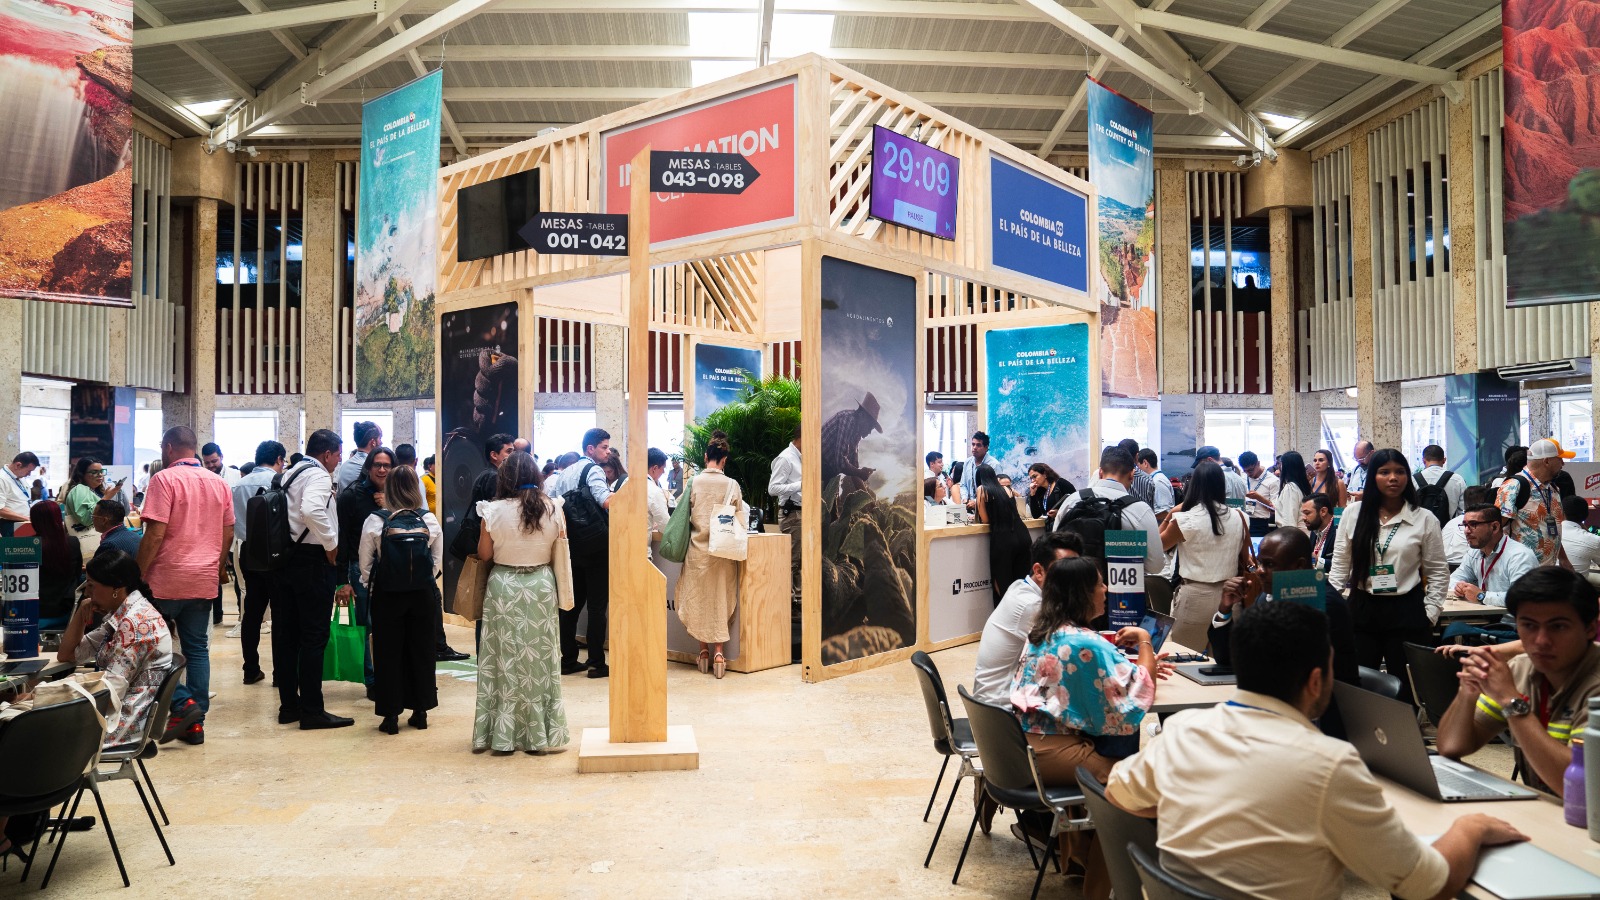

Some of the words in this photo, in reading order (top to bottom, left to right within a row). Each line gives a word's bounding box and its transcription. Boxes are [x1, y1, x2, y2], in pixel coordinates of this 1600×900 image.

[369, 140, 375, 149] EL
[389, 131, 397, 141] DE
[398, 128, 406, 138] LA
[406, 118, 431, 135] BELLEZA
[1095, 123, 1105, 134] THE
[668, 158, 711, 171] MESAS
[882, 141, 950, 197] 29:09
[662, 171, 745, 188] 043-098
[907, 210, 924, 222] PAUSE
[1020, 208, 1056, 233] COLOMBIA
[540, 218, 583, 230] MESAS
[547, 232, 627, 250] 001-042
[999, 218, 1008, 232] EL
[1010, 222, 1028, 239] PAÍS
[1030, 229, 1040, 243] DE
[1042, 233, 1052, 248] LA
[1053, 238, 1082, 258] BELLEZA
[1008, 358, 1023, 367] PAÍS
[1047, 356, 1076, 365] BELLEZA
[1016, 350, 1049, 358] COLOMBIA
[1110, 567, 1137, 586] 048
[1290, 586, 1317, 595] DIGITAL
